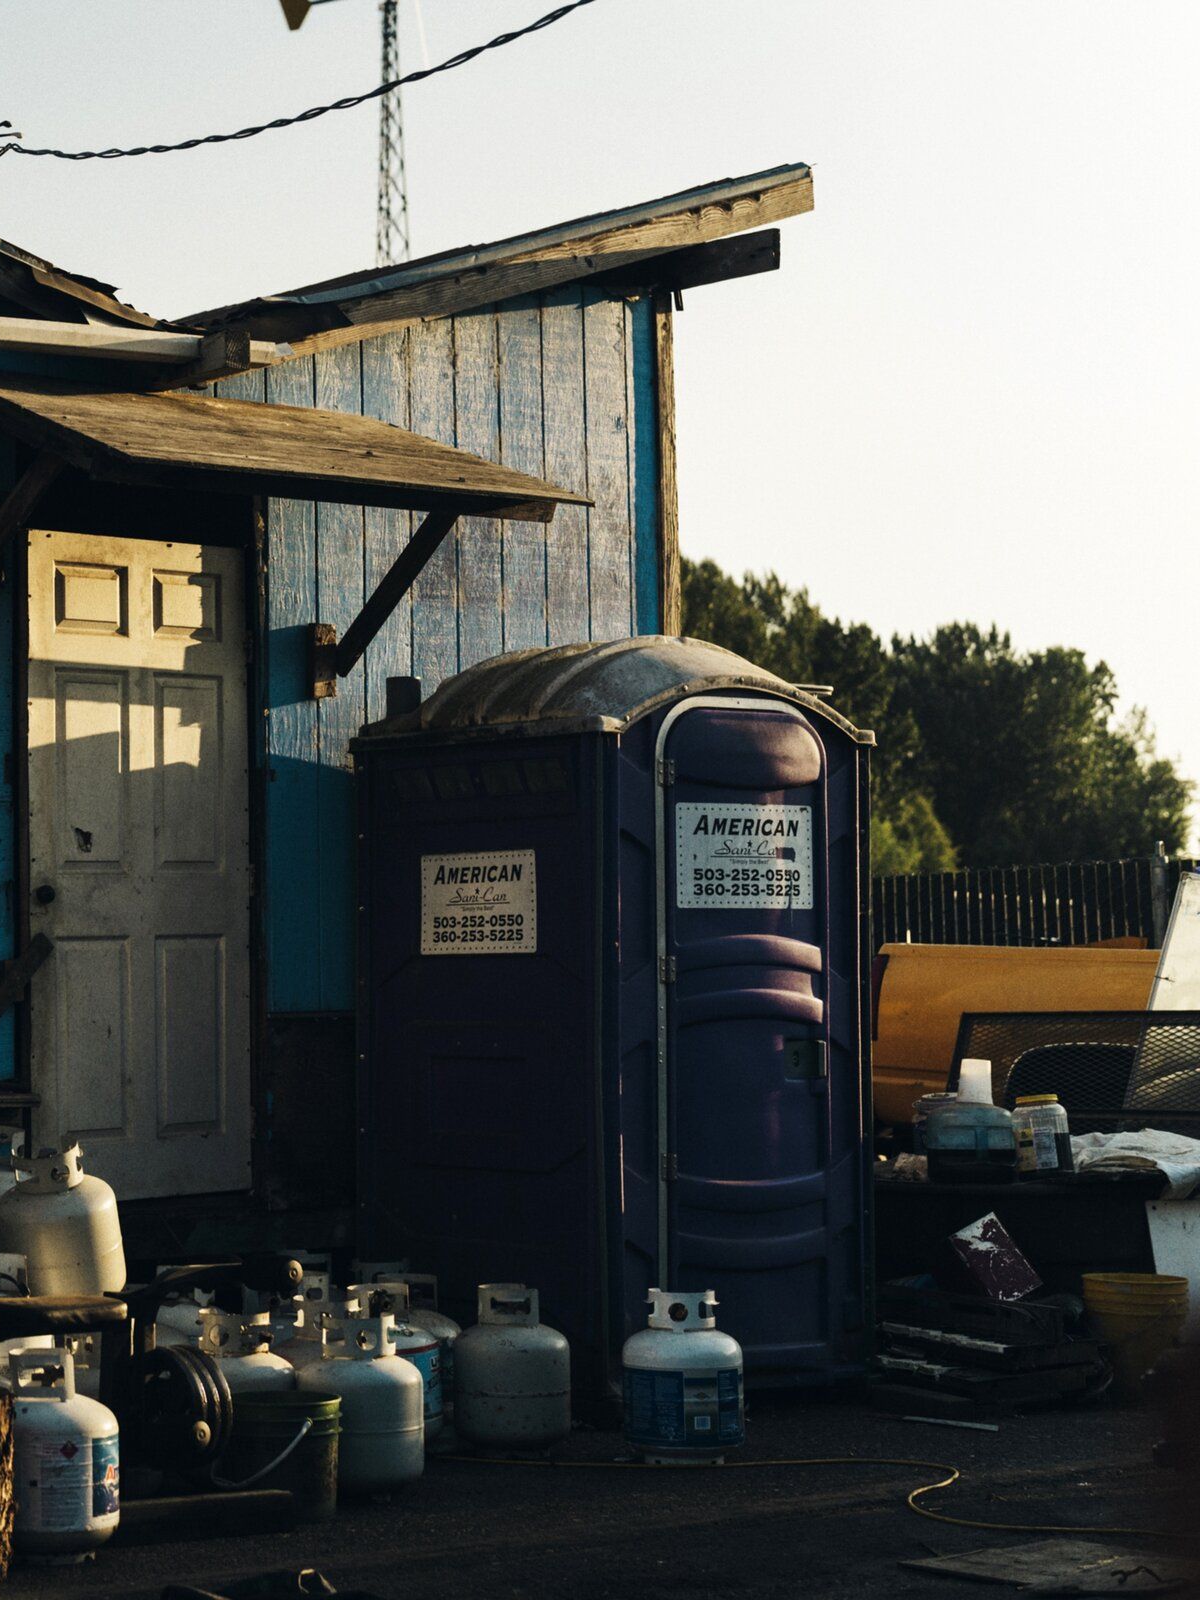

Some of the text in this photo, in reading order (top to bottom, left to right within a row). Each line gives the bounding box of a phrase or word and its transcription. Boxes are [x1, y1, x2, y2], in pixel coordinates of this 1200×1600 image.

[693, 815, 799, 837] AMERICAN
[714, 840, 778, 856] Sani-Ca
[433, 864, 523, 885] AMERICAN
[693, 868, 800, 882] 503-252-0550
[448, 886, 507, 903] Sani-Can
[693, 883, 800, 897] 360-253-5225
[433, 914, 524, 929] 503-252-0550
[433, 929, 524, 943] 360-253-5225
